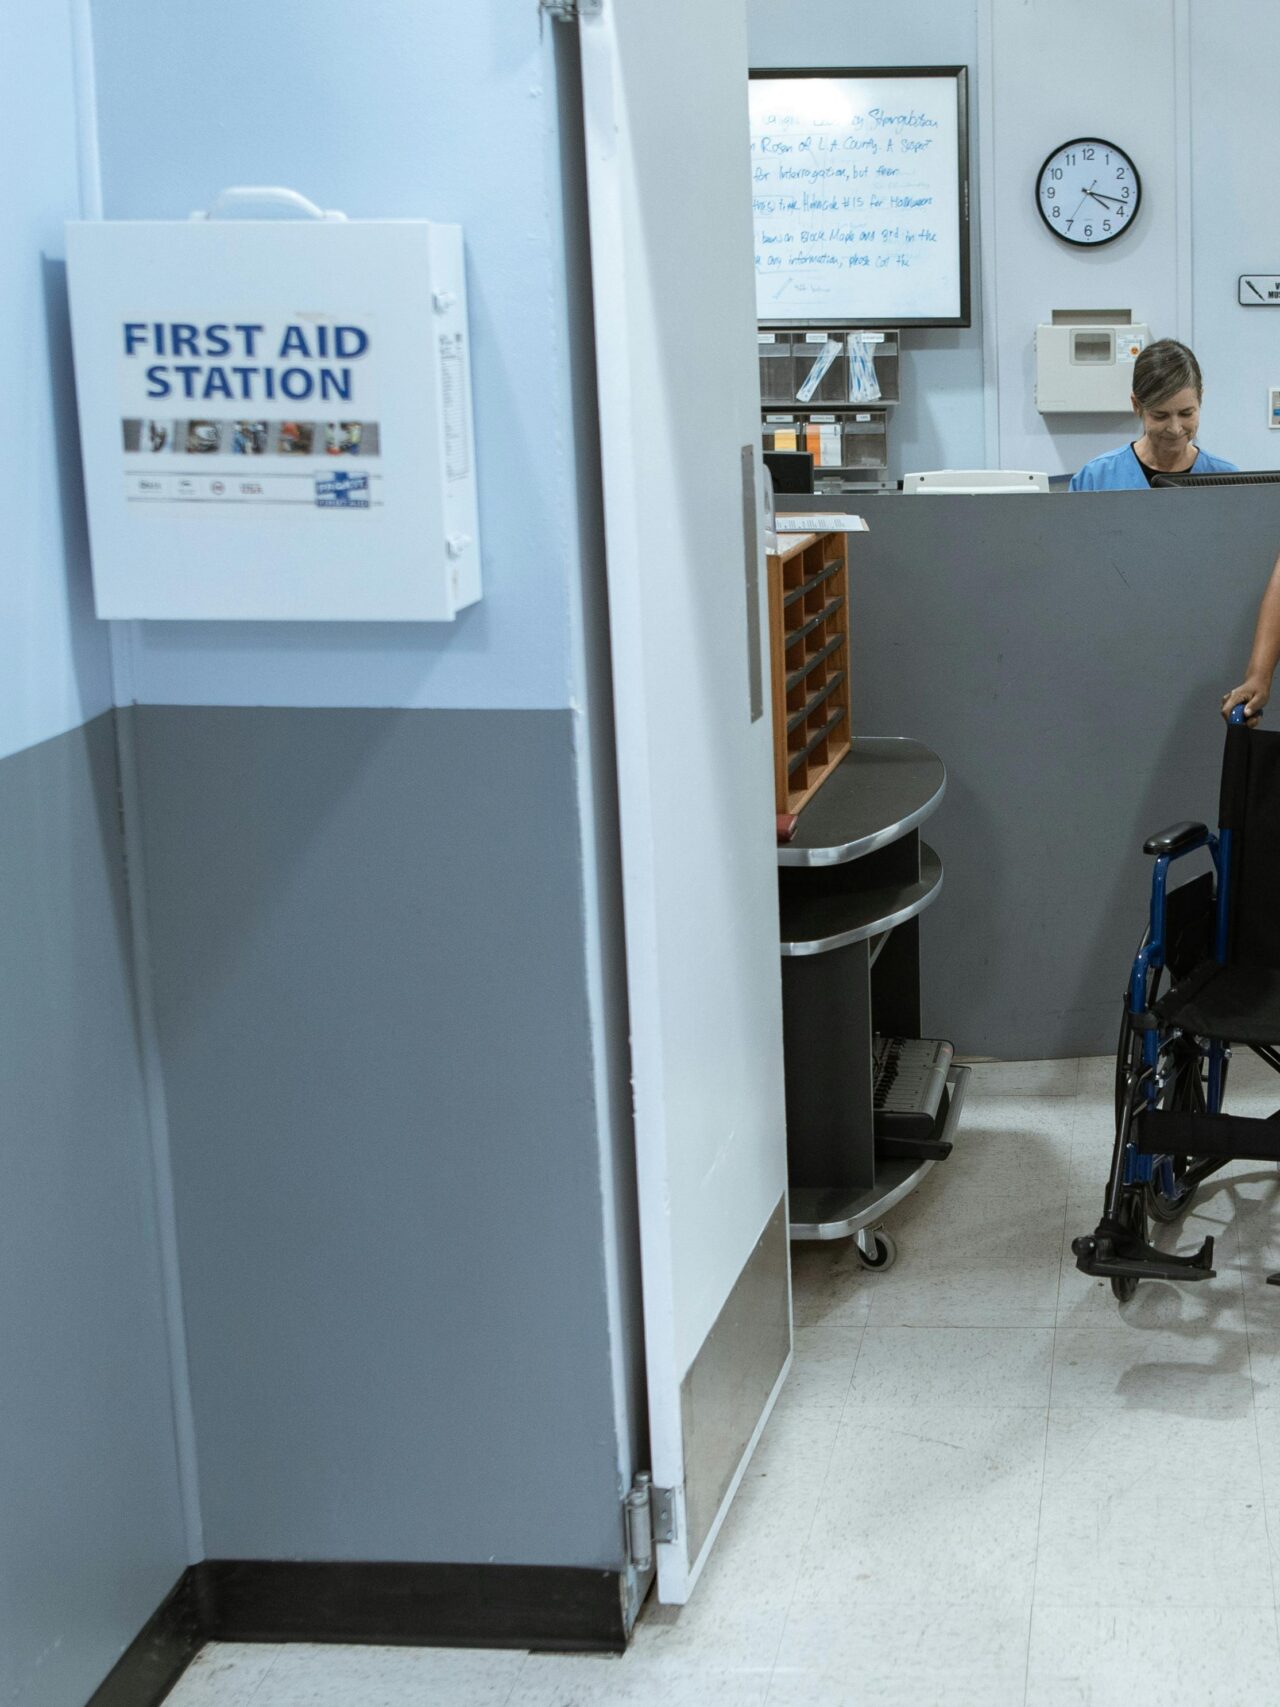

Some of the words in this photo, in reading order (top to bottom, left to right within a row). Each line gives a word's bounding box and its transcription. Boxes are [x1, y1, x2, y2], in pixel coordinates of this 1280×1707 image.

[1066, 154, 1076, 166] 11
[1082, 148, 1095, 160] 12
[852, 166, 869, 179] but
[1051, 168, 1063, 180] 10
[1116, 167, 1125, 180] 2
[1047, 187, 1056, 199] 9
[1121, 186, 1129, 199] 3
[1052, 206, 1061, 218] 8
[1116, 206, 1125, 218] 4
[1065, 219, 1074, 232] 7
[1084, 224, 1093, 237] 6
[1103, 219, 1111, 232] 5
[122, 322, 264, 357] FIRST
[279, 325, 370, 360] AID
[145, 365, 353, 402] STATION
